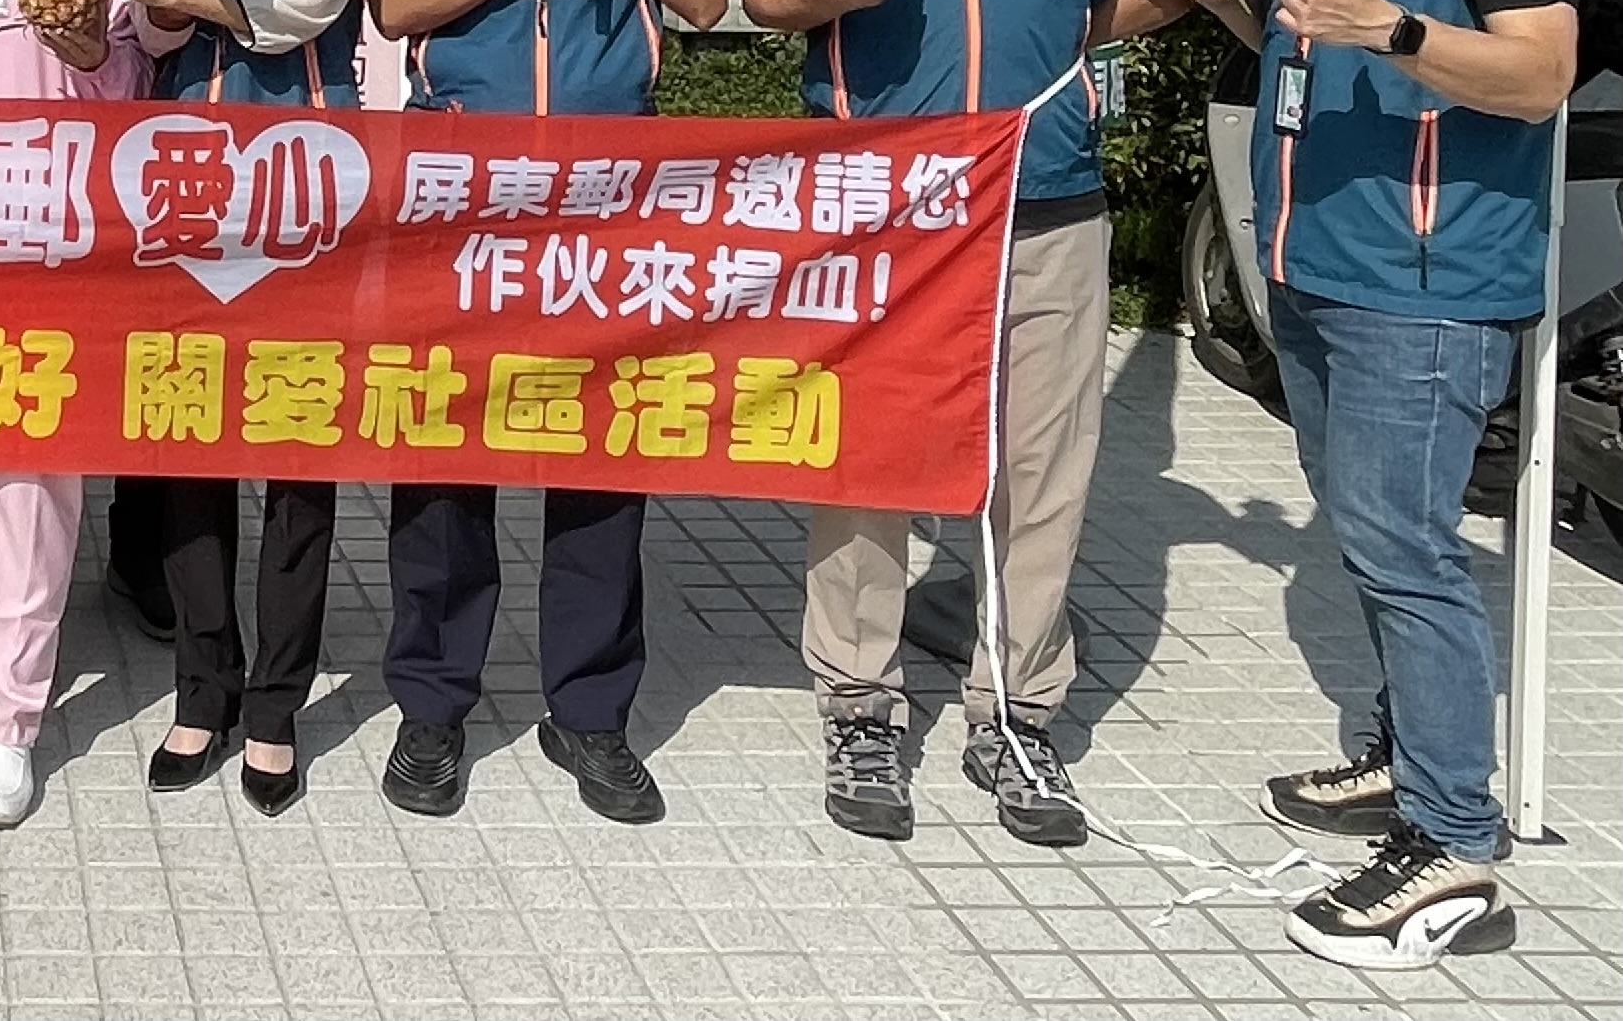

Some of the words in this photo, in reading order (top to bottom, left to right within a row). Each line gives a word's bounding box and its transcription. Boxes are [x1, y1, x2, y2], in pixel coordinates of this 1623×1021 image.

[133, 129, 339, 263] 愛心
[397, 150, 976, 235] 屏東郵局邀請您
[123, 332, 842, 469] 關愛社區活動
